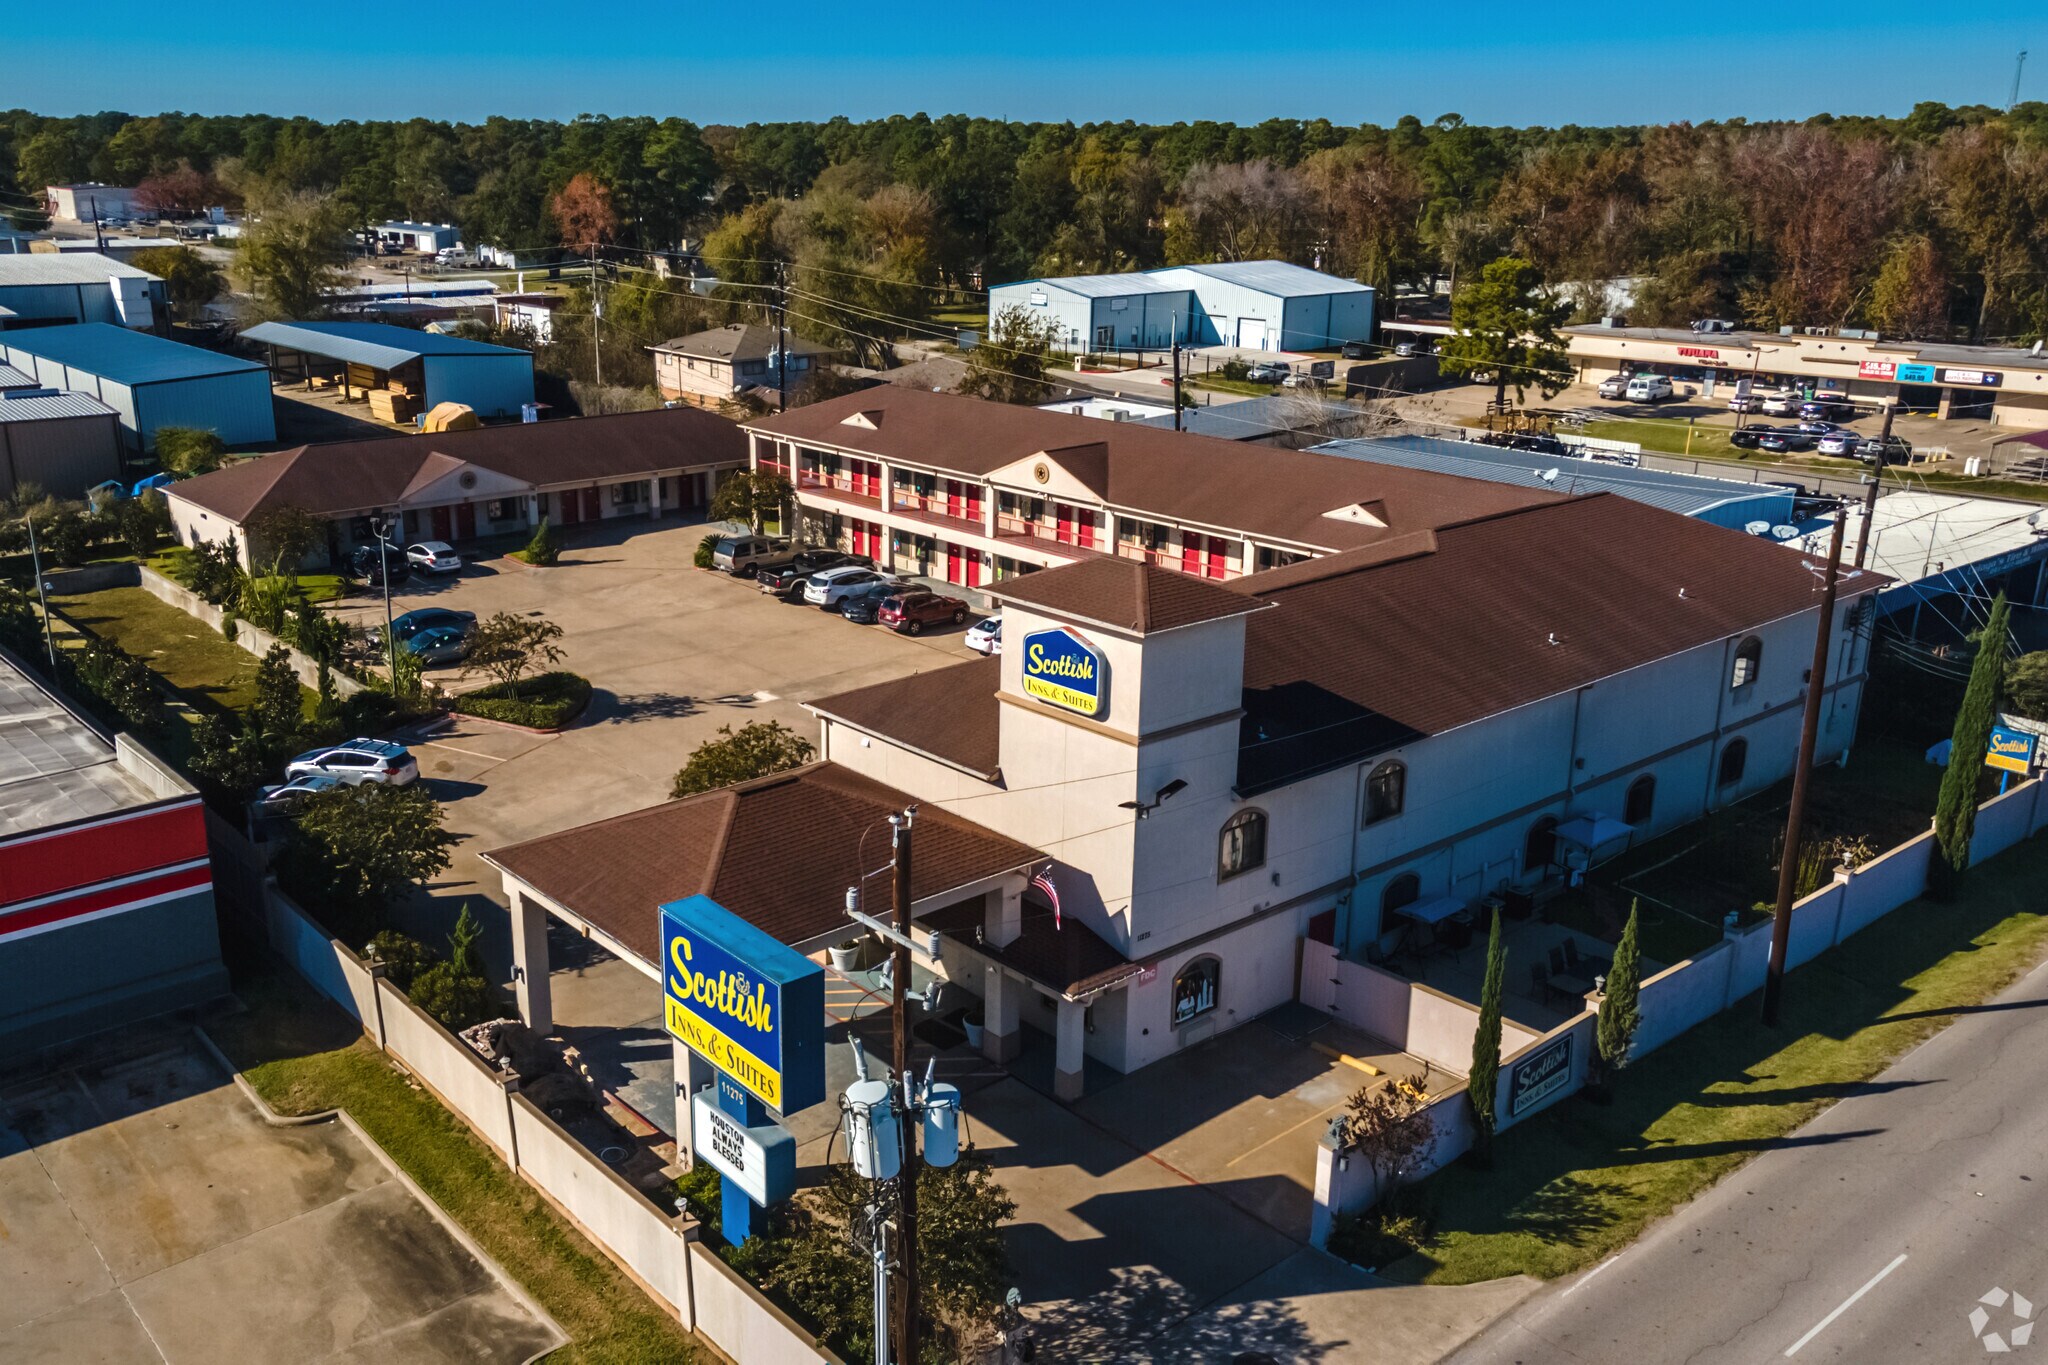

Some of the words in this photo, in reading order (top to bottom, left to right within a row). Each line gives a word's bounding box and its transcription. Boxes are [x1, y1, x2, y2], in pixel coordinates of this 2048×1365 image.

[1028, 644, 1093, 679] Scottish
[1051, 688, 1060, 700] &
[1063, 691, 1093, 710] SUITES
[1990, 734, 2028, 753] Scottish
[1137, 931, 1151, 942] 11275
[670, 936, 773, 1032] Scottish
[708, 1034, 722, 1060] &
[726, 1044, 775, 1098] SUITES
[1518, 1043, 1567, 1095] Scottish
[722, 1081, 744, 1105] 11275
[710, 1111, 745, 1147] HOUSTON
[712, 1126, 743, 1157] ALWAYS
[712, 1139, 745, 1172] BLESSED
